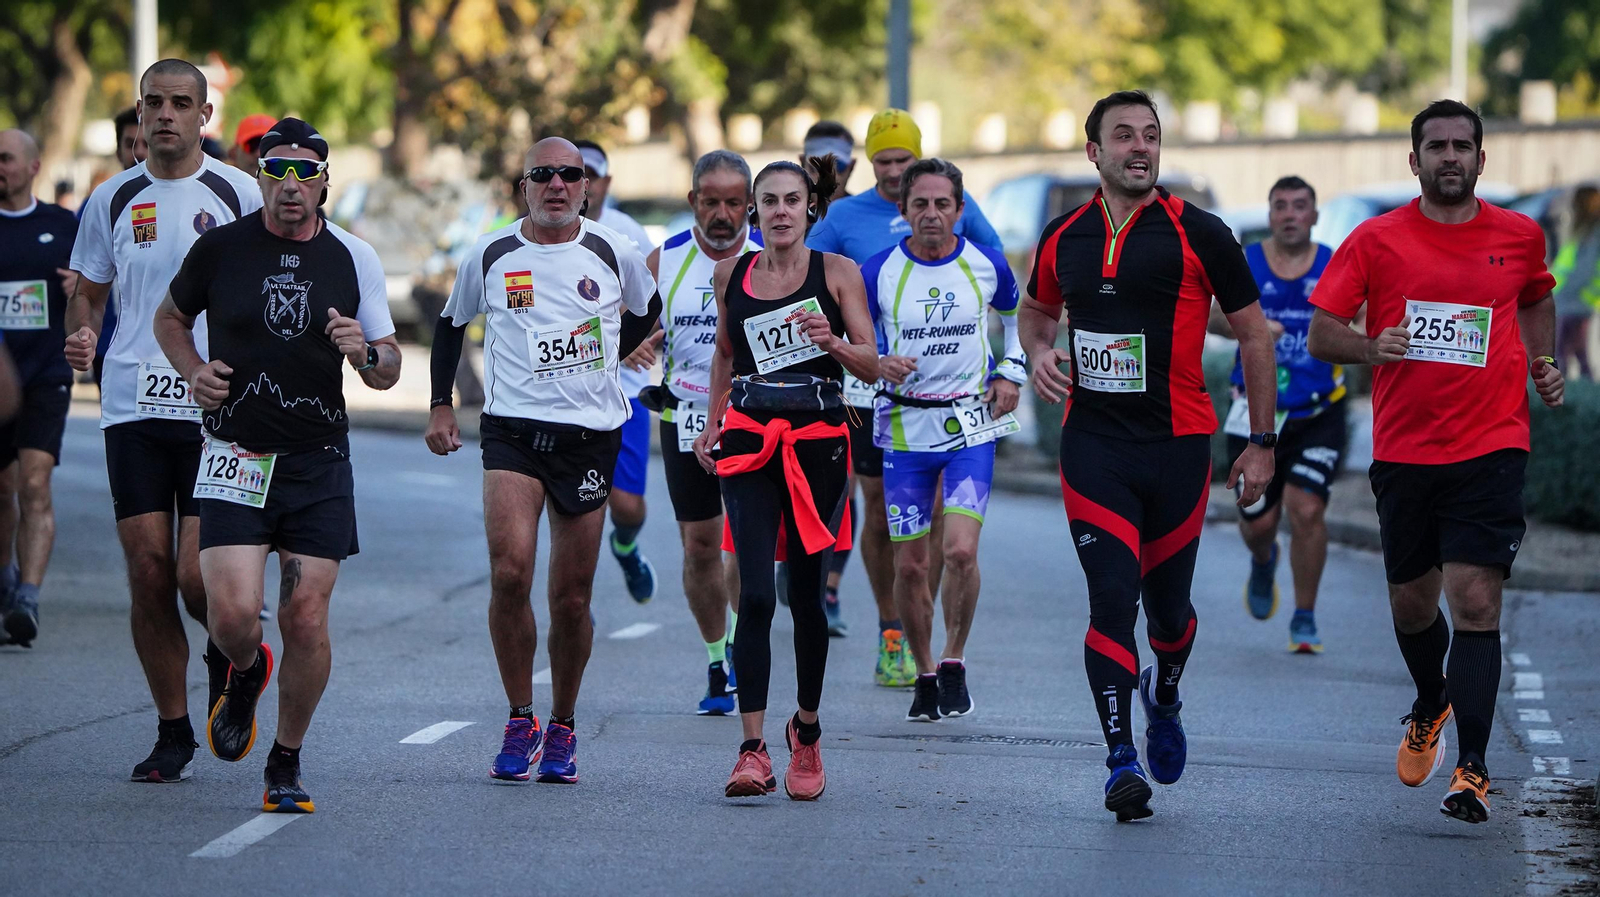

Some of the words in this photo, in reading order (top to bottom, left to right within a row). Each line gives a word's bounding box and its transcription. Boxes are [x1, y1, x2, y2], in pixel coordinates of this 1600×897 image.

[139, 242, 152, 250] 2013
[757, 323, 794, 352] 127
[902, 323, 976, 340] VETE-RUNNERS
[1413, 316, 1456, 342] 255
[537, 336, 578, 363] 354
[922, 342, 960, 356] JEREZ
[1081, 346, 1112, 372] 500
[145, 374, 186, 399] 225
[206, 454, 239, 480] 128
[578, 489, 608, 501] Sevilla
